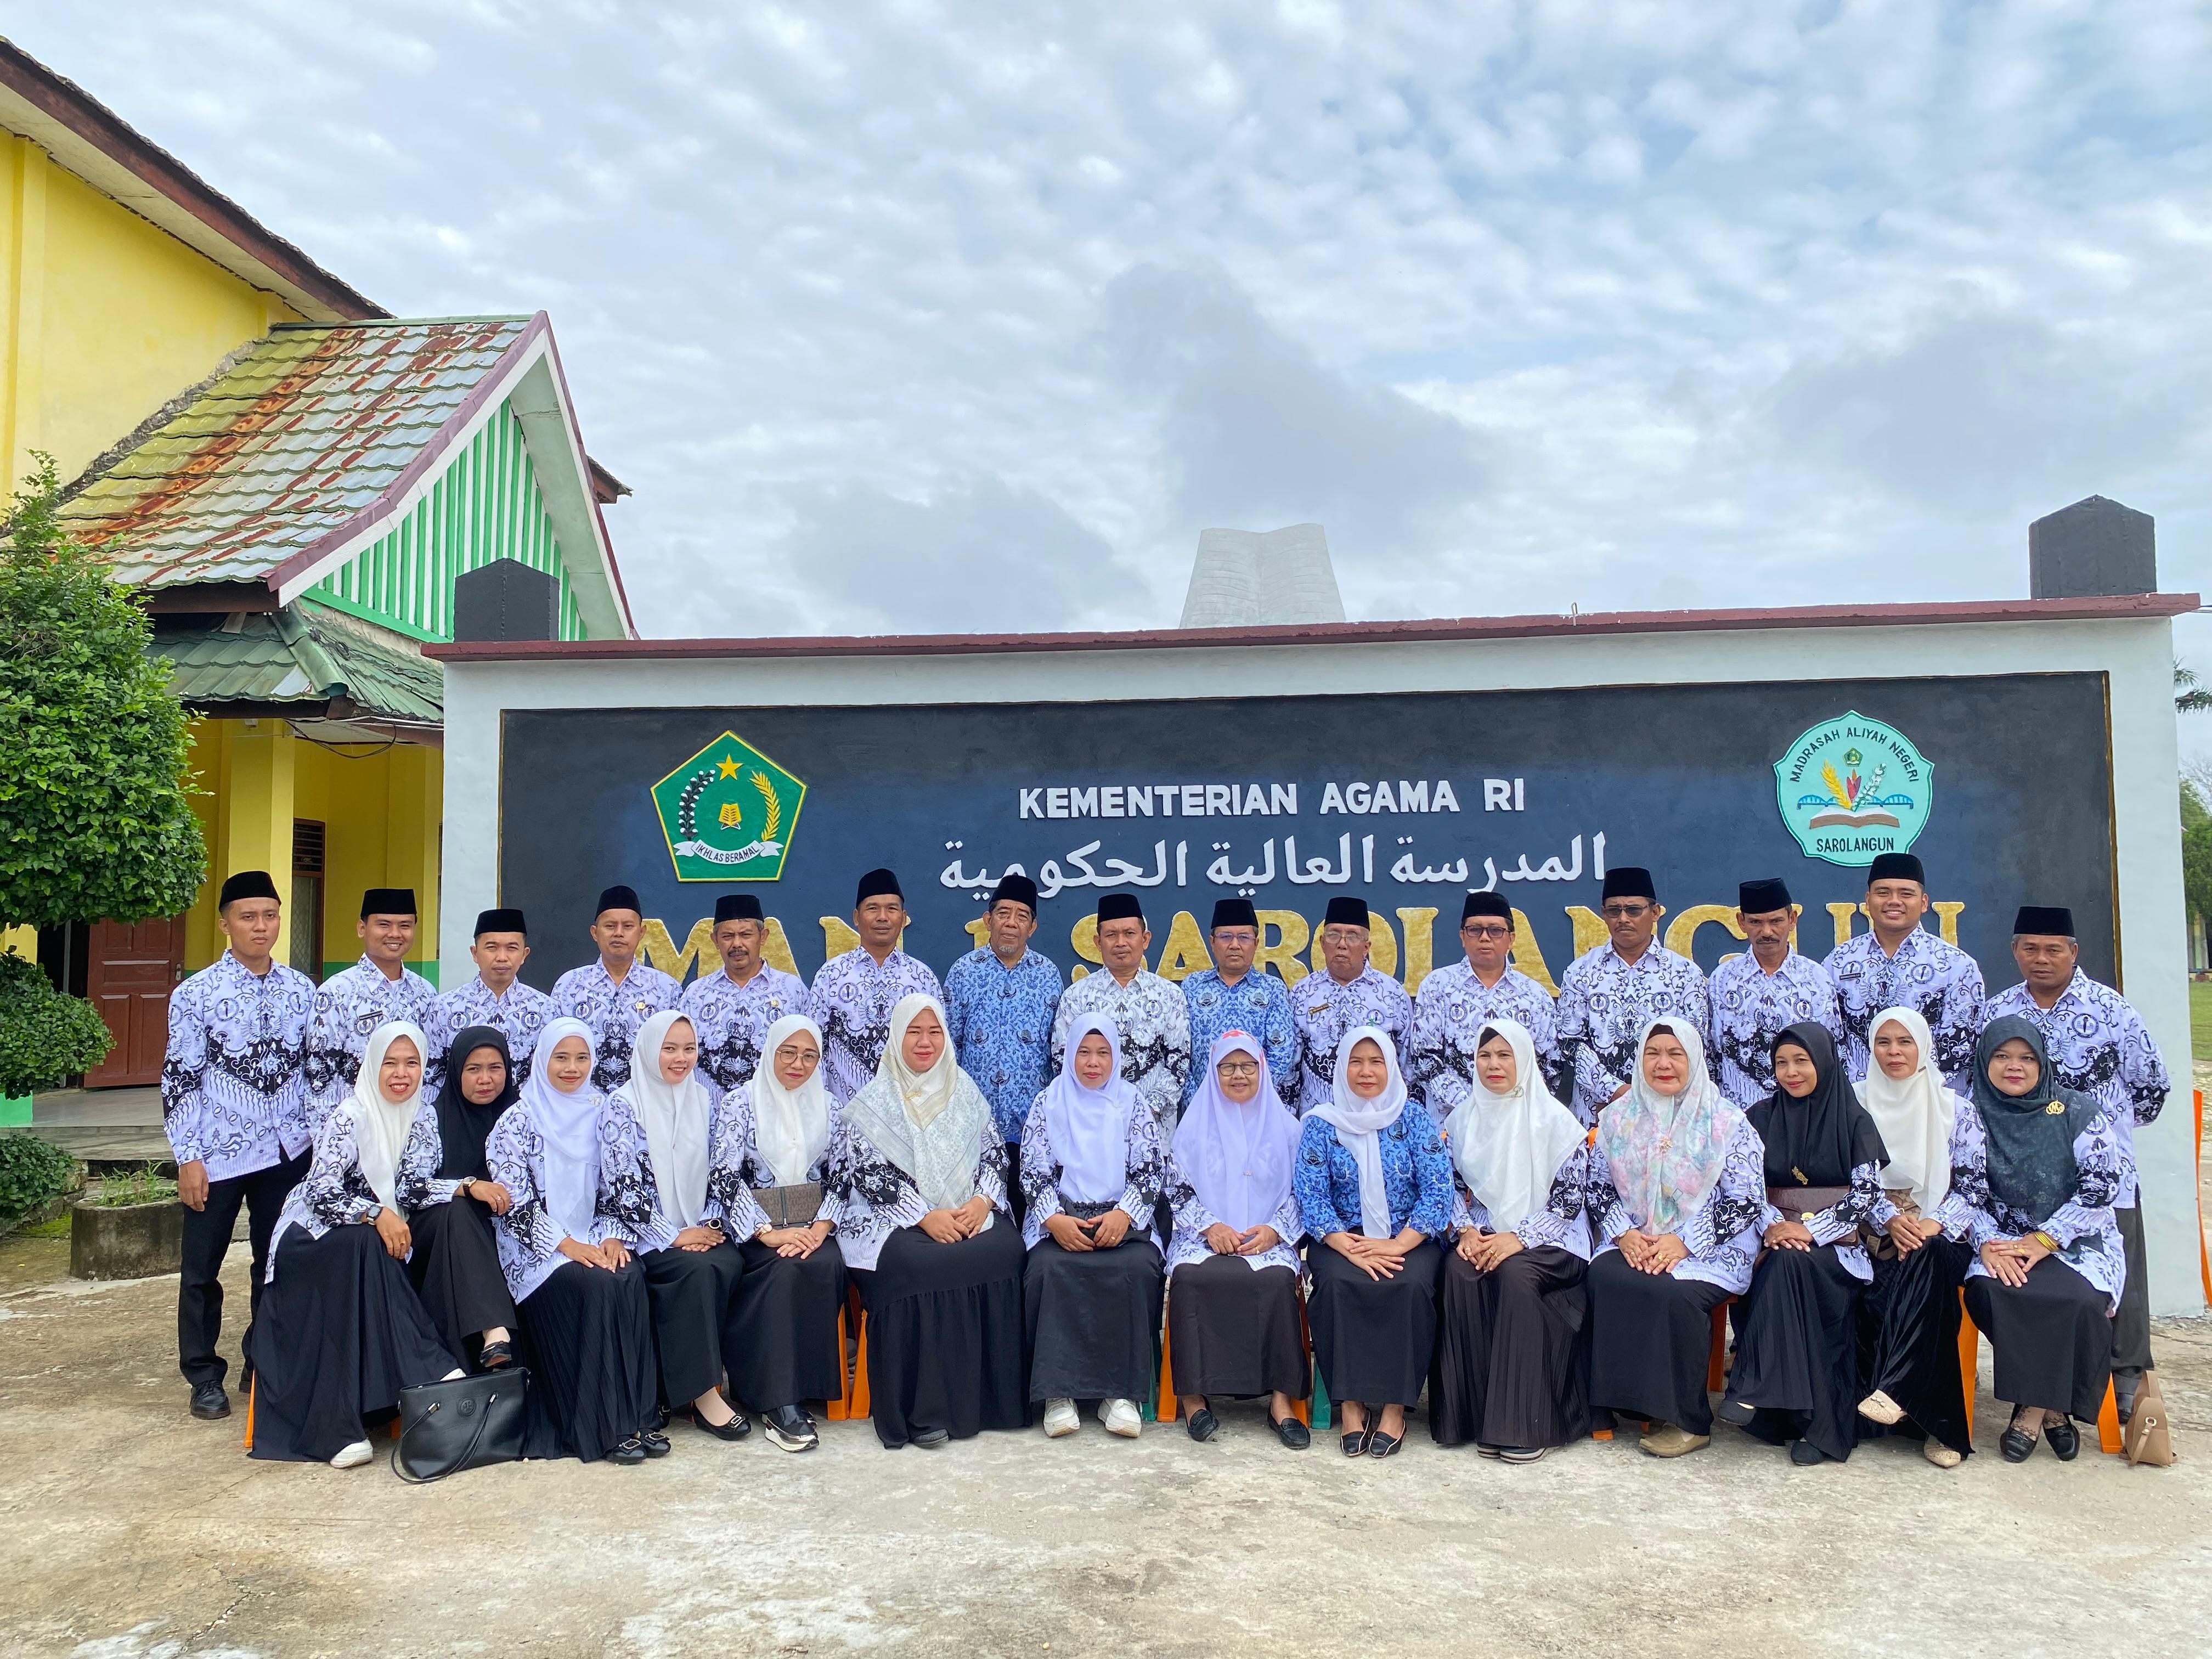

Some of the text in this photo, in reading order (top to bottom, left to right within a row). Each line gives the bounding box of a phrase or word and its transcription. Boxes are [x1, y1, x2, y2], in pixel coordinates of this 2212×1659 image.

[1789, 727, 1920, 782] MADRASAH ALIYAH NEGERI
[1019, 778, 1525, 819] KEMENTERIAN AGAMA RI
[695, 844, 760, 862] IKHLAS BERAMAL
[940, 831, 1606, 901] المدرسة العالية الحكومية
[1816, 837, 1894, 852] SAROLANGUN
[1071, 900, 1965, 997] SAROLAG
